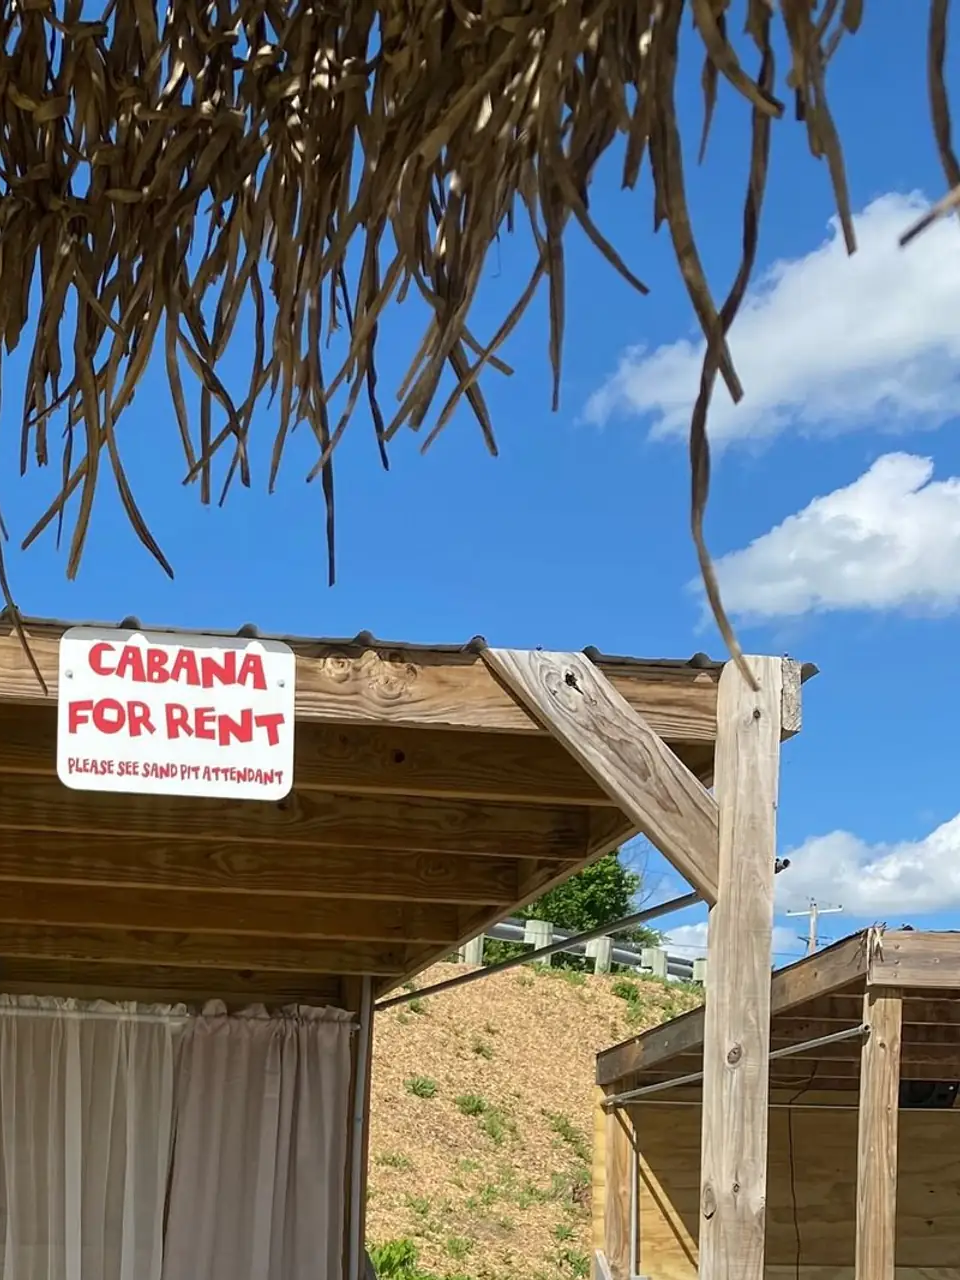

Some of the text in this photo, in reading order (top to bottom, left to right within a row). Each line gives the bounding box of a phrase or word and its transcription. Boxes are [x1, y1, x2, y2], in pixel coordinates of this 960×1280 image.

[88, 643, 267, 690] CABANA
[69, 698, 285, 746] FOR RENT
[68, 757, 283, 785] PLEASE SEE SAND PIT ATTENDANT
